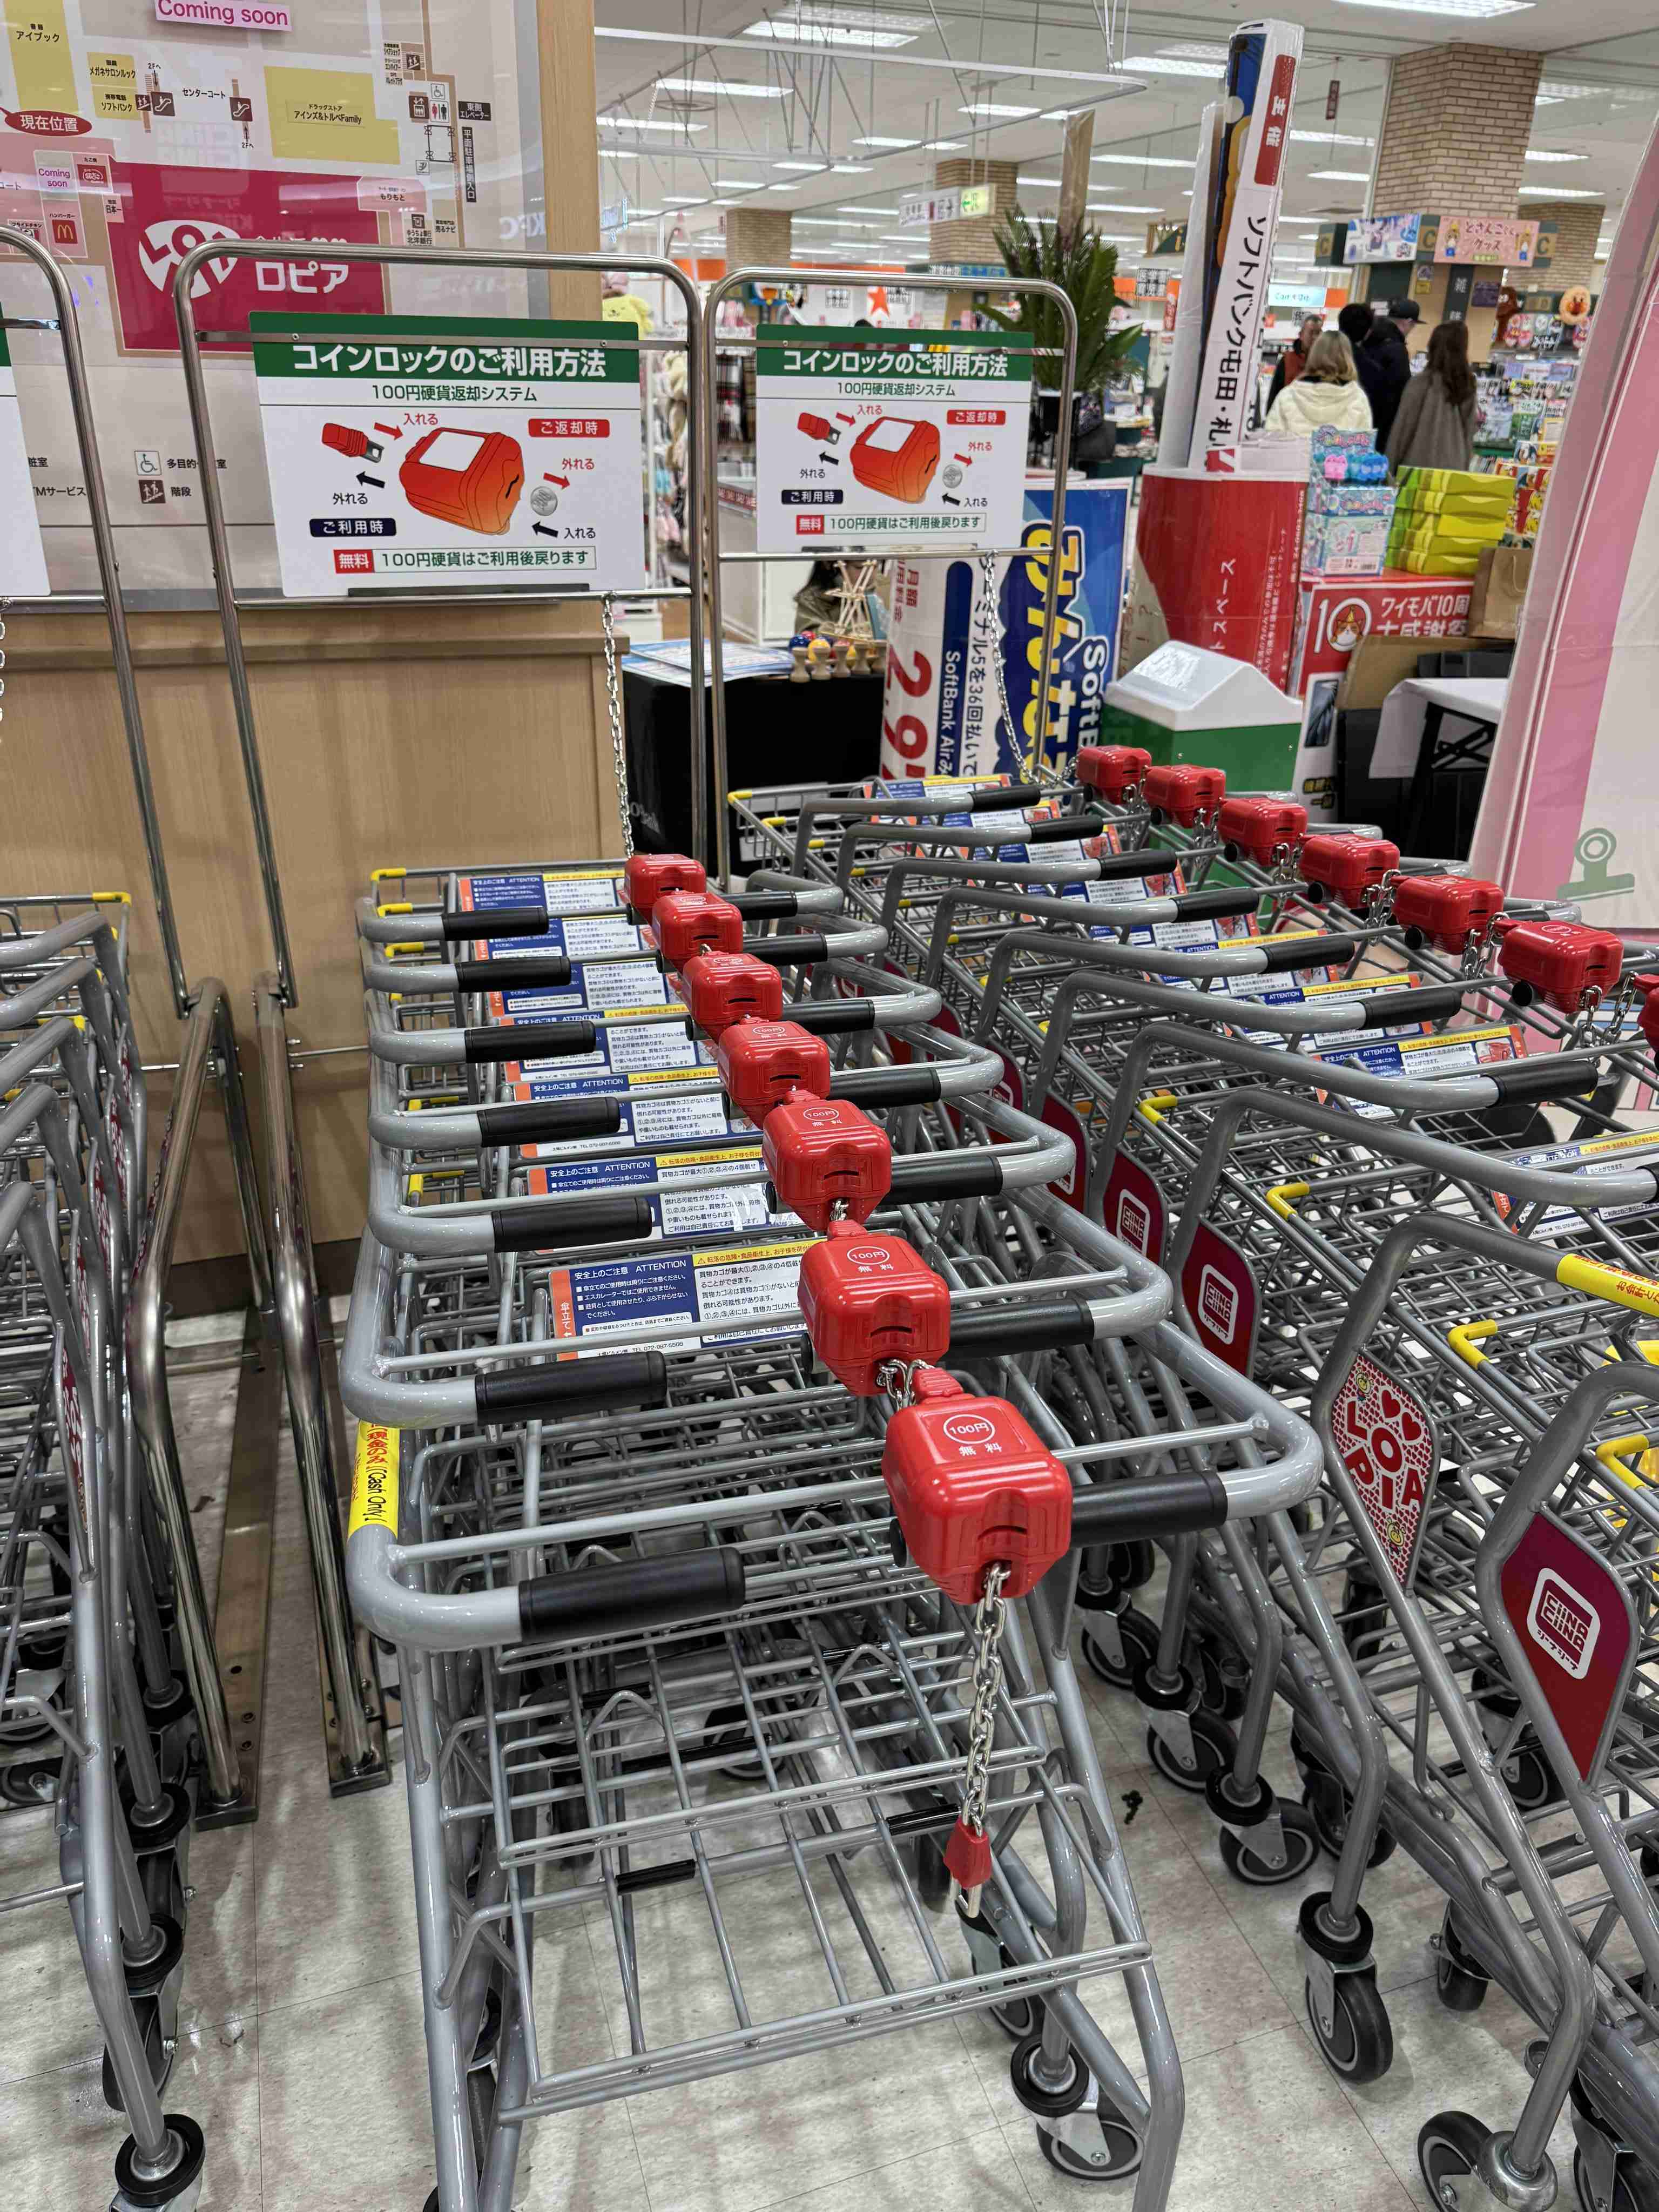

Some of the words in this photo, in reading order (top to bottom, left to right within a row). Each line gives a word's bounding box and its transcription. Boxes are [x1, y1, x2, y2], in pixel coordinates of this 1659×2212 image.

[158, 0, 235, 25] Coming
[241, 9, 288, 26] soon
[16, 31, 59, 43] アイブック
[90, 67, 136, 78] メガネサロンルック
[182, 87, 226, 99] センターコート
[101, 102, 133, 112] ソフトバンク
[460, 110, 489, 119] エレベーター
[20, 114, 79, 132] 現在位置
[38, 168, 70, 179] Coming
[48, 180, 68, 188] soon
[380, 193, 406, 201] もりもと
[255, 260, 349, 294] ロピア
[1208, 215, 1266, 447] ソフトバンク屯田・札
[293, 344, 606, 377] コインロックのご利用方法
[783, 350, 1008, 377] コインロックのご利用方法
[373, 384, 537, 402] 100円硬貨返却システム
[838, 382, 955, 397] 100円硬貨返却システム
[857, 404, 882, 415] 入れる
[403, 413, 438, 426] 入れる
[955, 412, 997, 423] ご返却時
[541, 421, 598, 435] ご返却時
[968, 441, 993, 452] 外れる
[562, 457, 595, 470] 外れる
[799, 468, 826, 479] 外れる
[171, 487, 192, 497] 階段
[332, 492, 368, 505] 外れる
[790, 491, 835, 503] ご利用時
[964, 497, 988, 508] 入れる
[322, 520, 384, 535] ご利用時
[799, 517, 821, 531] 無料
[830, 516, 981, 530] 100円硬貨はご利用後戻ります
[564, 527, 596, 539] 入れる
[338, 553, 370, 569] 無料
[382, 549, 588, 567] 100円硬貨はご利用後戻ります
[906, 568, 920, 608] 月額
[941, 650, 961, 730] SoftBank
[1269, 992, 1300, 1000] ATTENTION
[1363, 1046, 1395, 1057] ATTENTION
[534, 1082, 577, 1092] 安全上のご注意
[583, 1078, 624, 1088] ATTENTION
[550, 1166, 598, 1178] 安全上のご注意
[604, 1161, 650, 1172] ATTENTION
[852, 1250, 887, 1260] 100円
[574, 1266, 629, 1280] 安全上のご注意
[636, 1259, 686, 1273] ATTENTION
[858, 1263, 894, 1273] 無料
[701, 1276, 752, 1289] ることができます。
[703, 1294, 774, 1310] 倒れる可能性があります。
[586, 1311, 616, 1319] でください。
[949, 1422, 990, 1435] 100円
[959, 1442, 1003, 1456] 無料
[1537, 1629, 1579, 1670] シーナシーナ
